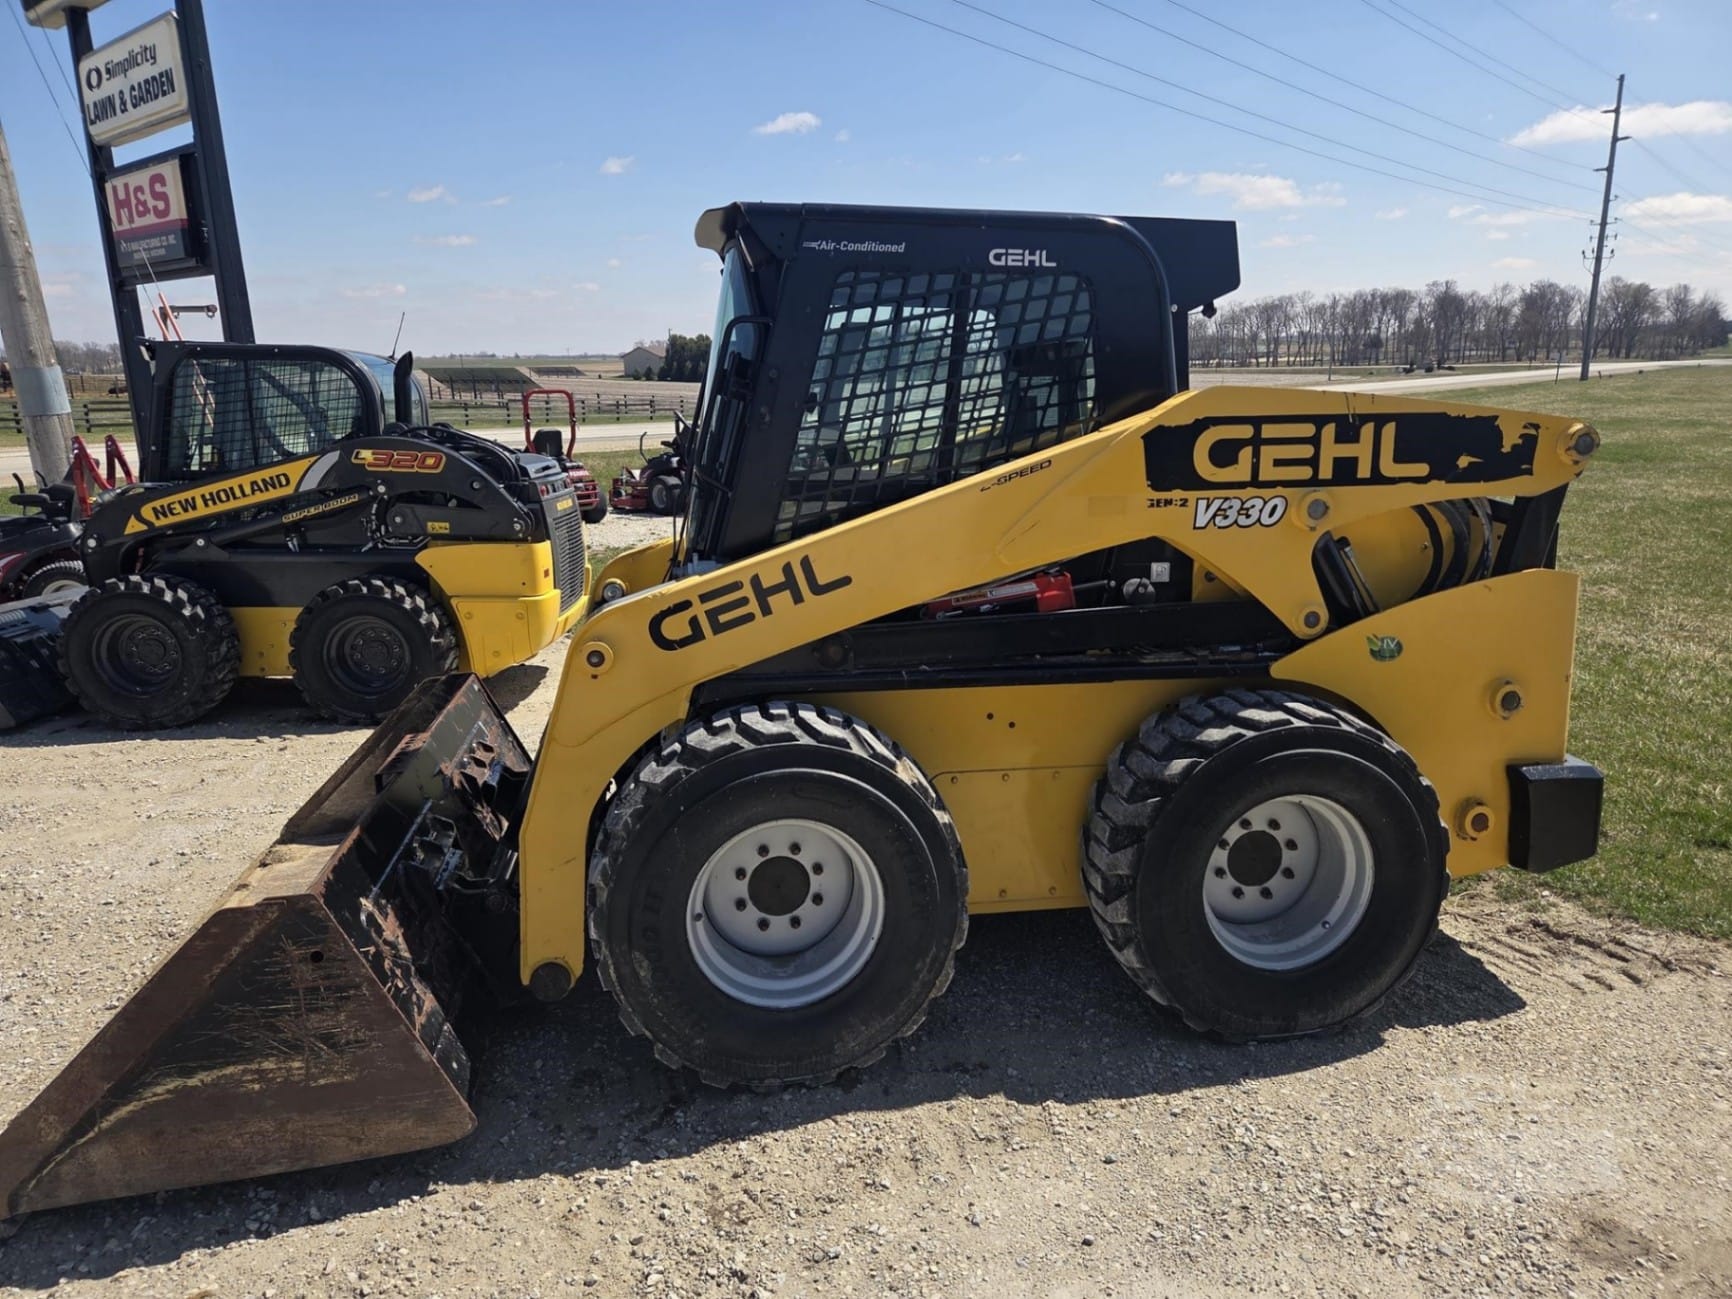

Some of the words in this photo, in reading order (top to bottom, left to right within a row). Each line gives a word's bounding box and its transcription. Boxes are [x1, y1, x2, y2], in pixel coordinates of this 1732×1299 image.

[104, 43, 157, 81] Simplicity
[86, 94, 117, 126] LAWN
[118, 89, 128, 114] &
[129, 67, 176, 109] GARDEN
[112, 172, 171, 226] H&S
[819, 239, 906, 253] Air-Conditioned
[988, 248, 1057, 267] GEHL
[1193, 421, 1430, 482] GEHL
[151, 495, 198, 521] NEW
[203, 472, 291, 507] HOLLAND
[1193, 495, 1288, 530] V330
[648, 554, 852, 651] GEHL
